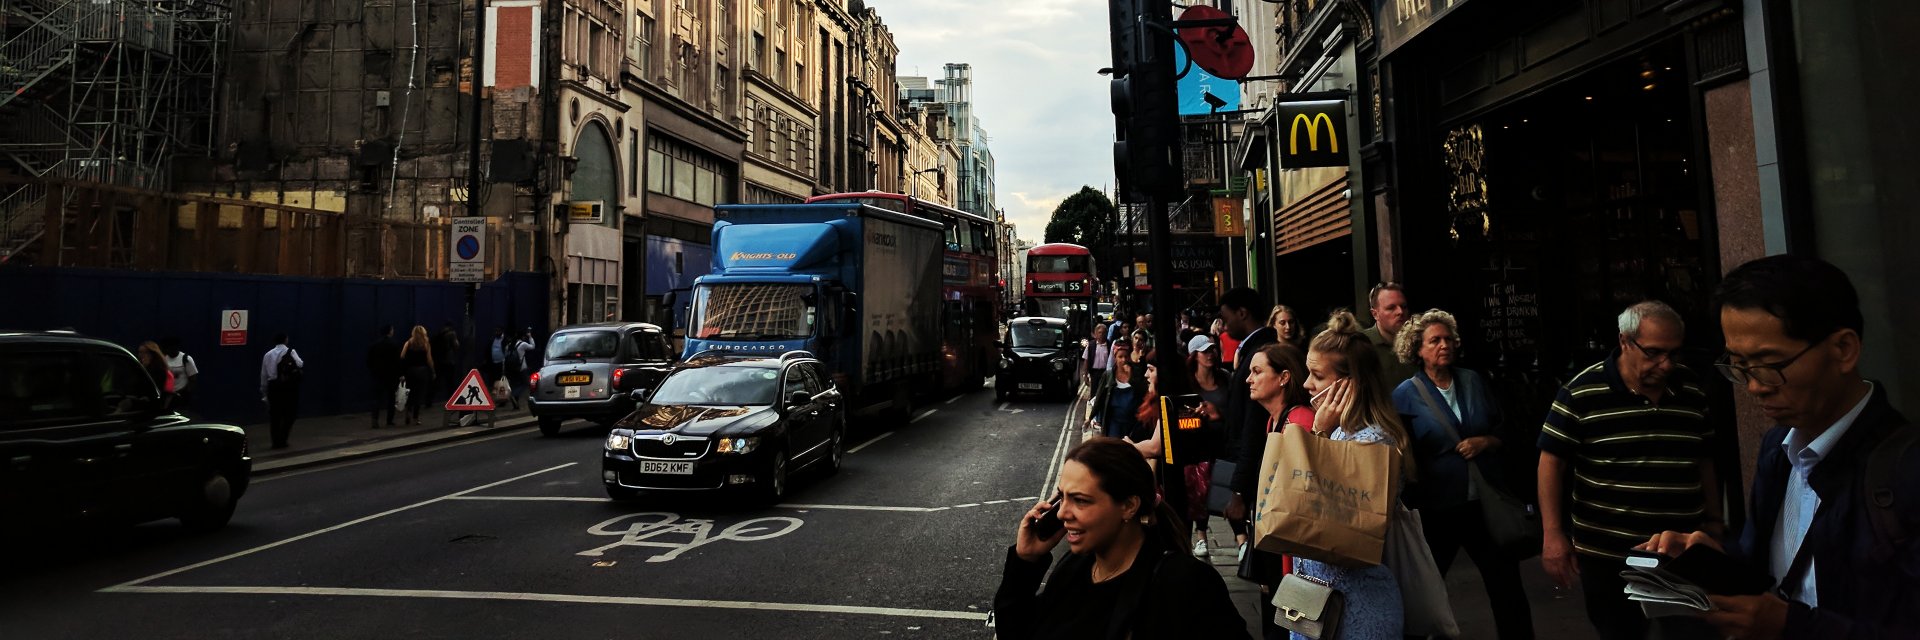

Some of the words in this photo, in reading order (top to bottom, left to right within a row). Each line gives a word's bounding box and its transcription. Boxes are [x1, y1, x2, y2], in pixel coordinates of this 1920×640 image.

[1458, 172, 1476, 195] BAR
[458, 225, 479, 233] ZONE
[730, 251, 772, 261] KNIGHTS
[775, 252, 797, 260] OLD
[1069, 282, 1080, 291] 55
[1178, 418, 1201, 429] WAIT
[644, 462, 669, 472] BD62
[670, 463, 689, 473] KMF
[1291, 468, 1372, 502] PRIMARK
